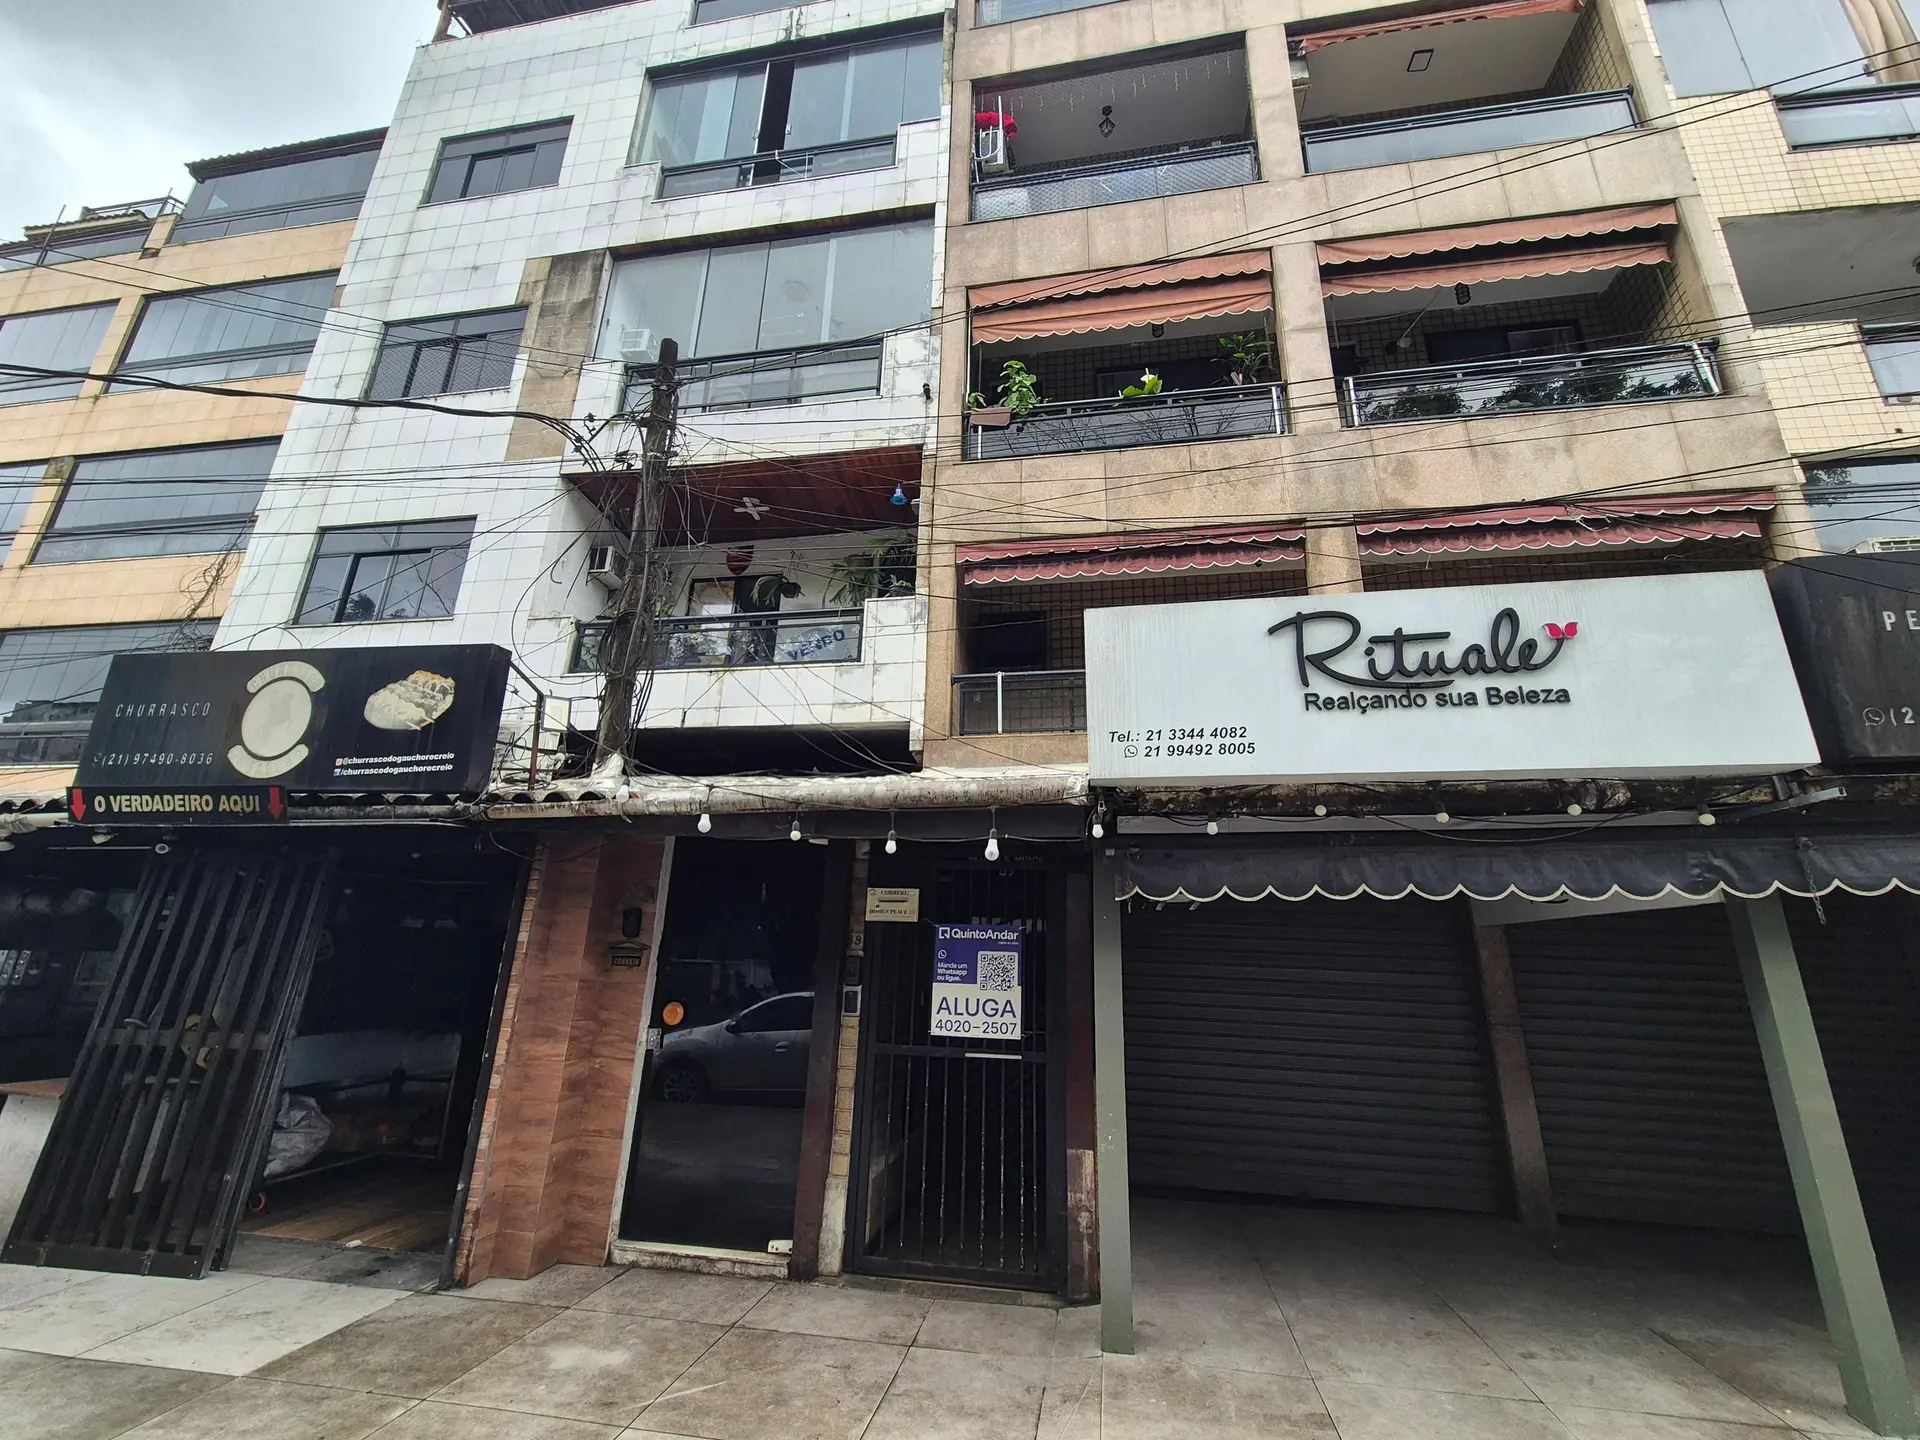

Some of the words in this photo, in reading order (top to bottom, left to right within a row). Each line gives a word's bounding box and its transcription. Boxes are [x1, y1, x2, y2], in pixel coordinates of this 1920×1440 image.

[1267, 607, 1566, 689] Rituale
[1304, 690, 1428, 714] Realçando
[1435, 690, 1479, 707] sua
[1485, 686, 1571, 706] Beleza
[115, 702, 211, 718] CHURRASCO
[1109, 730, 1140, 742] Tel.:
[1146, 729, 1162, 741] 21
[1168, 728, 1205, 740] 3344
[1210, 726, 1247, 739] 4082
[1144, 745, 1160, 757] 21
[1167, 744, 1213, 756] 99492
[1218, 742, 1256, 755] 8005
[94, 795, 106, 813] O
[109, 794, 213, 813] VERDADEIRO
[218, 794, 260, 814] AQUI
[951, 927, 1020, 941] QuintoAndar
[937, 961, 956, 969] Mande
[937, 968, 967, 977] Whatsapp
[936, 996, 1017, 1019] ALUGA
[935, 1019, 1018, 1036] 4020-2507
